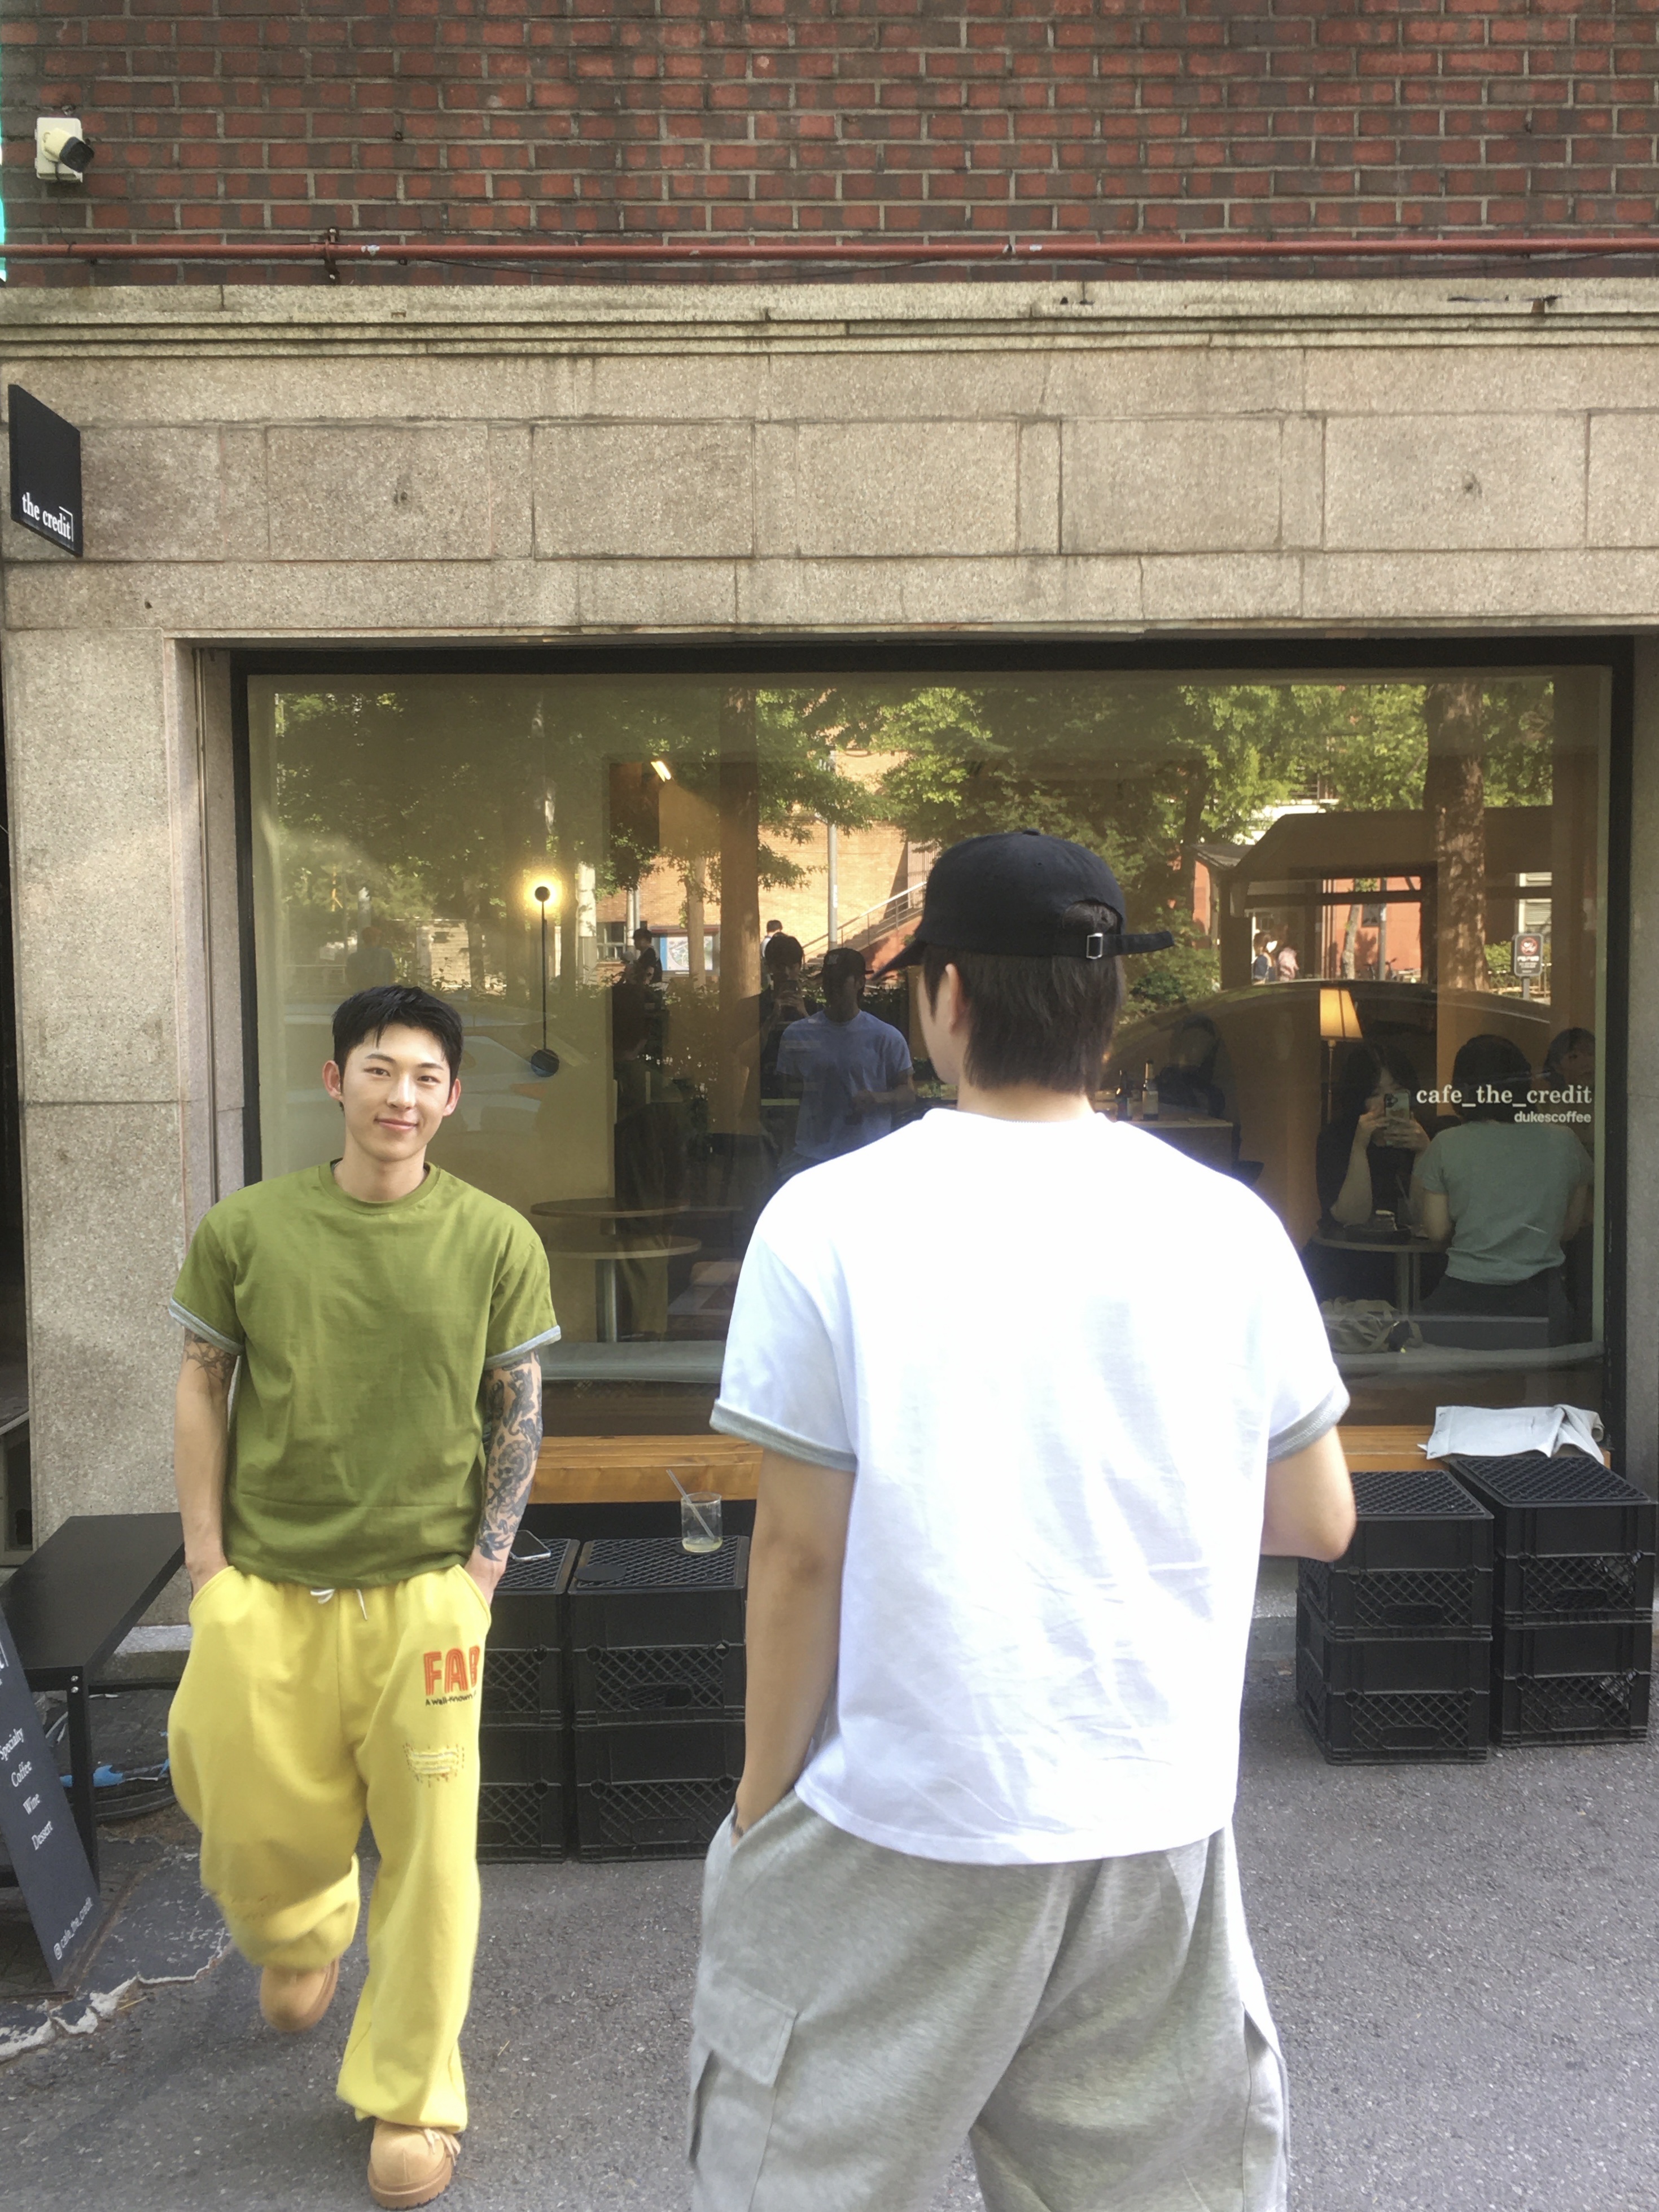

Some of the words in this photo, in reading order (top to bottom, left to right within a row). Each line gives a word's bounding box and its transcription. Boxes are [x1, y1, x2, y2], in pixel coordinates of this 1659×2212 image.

[22, 492, 40, 520] the
[42, 510, 71, 540] credit
[1416, 1084, 1592, 1107] cafe_the_credit
[1514, 1111, 1591, 1123] dukescoffee
[11, 1760, 32, 1788] Coffee
[23, 1793, 41, 1815] Wine
[31, 1820, 53, 1851] Dessert
